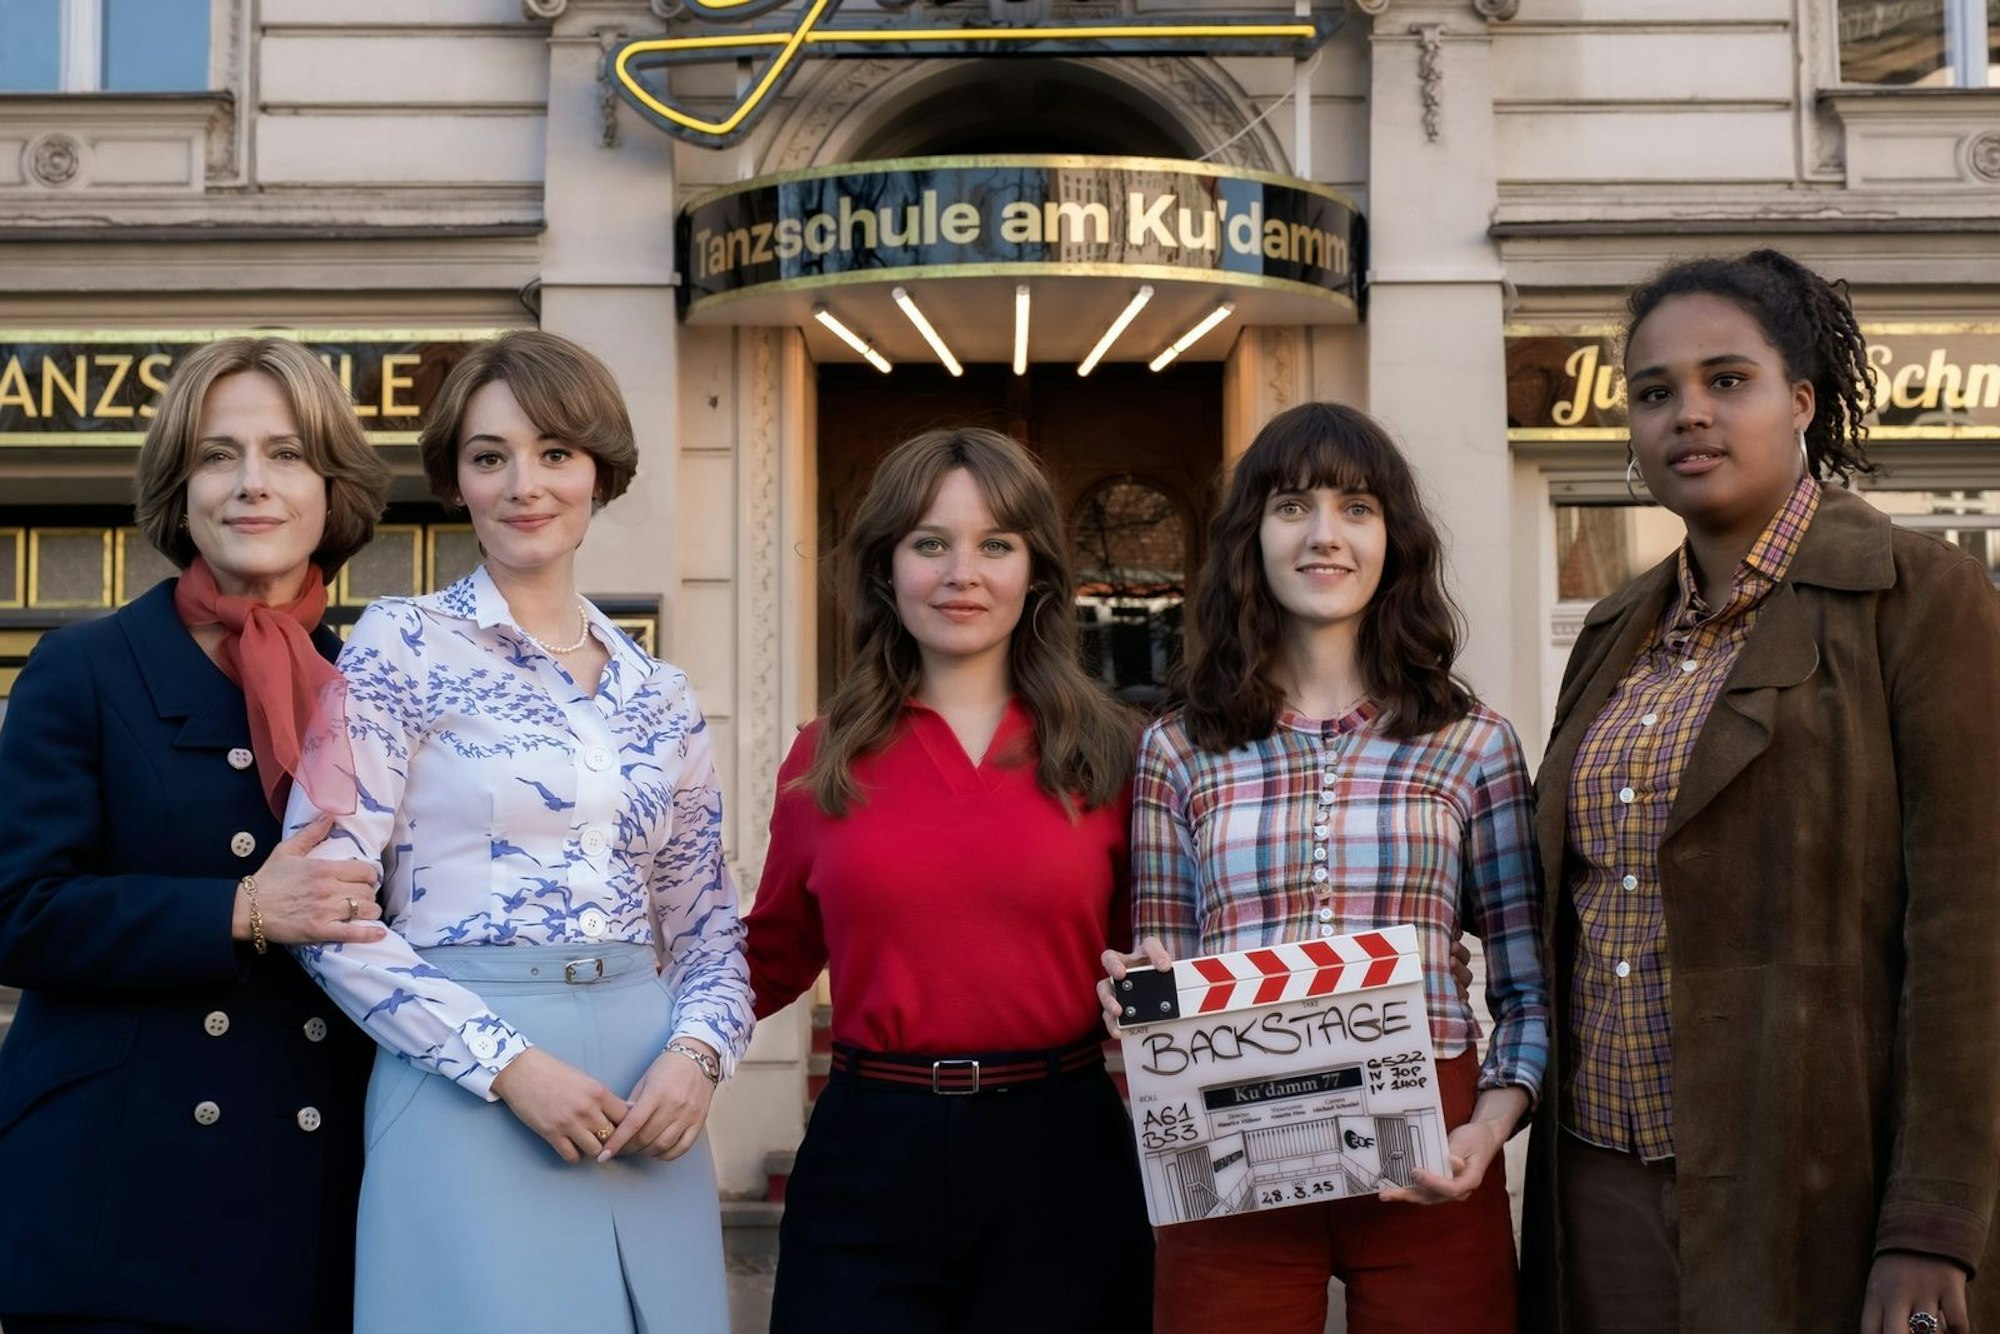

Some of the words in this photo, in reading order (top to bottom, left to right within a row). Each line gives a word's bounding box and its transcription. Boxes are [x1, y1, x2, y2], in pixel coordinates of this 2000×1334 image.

[696, 189, 981, 280] Tanzschule
[1001, 199, 1110, 246] am
[1128, 191, 1349, 272] Ku'damm
[0, 353, 422, 418] ANZSLE
[1141, 1001, 1412, 1076] BACKSTAGE
[1234, 1080, 1318, 1102] Ku'damm
[1321, 1072, 1341, 1088] 77
[1142, 1123, 1199, 1149] B53
[1143, 1102, 1195, 1131] A61
